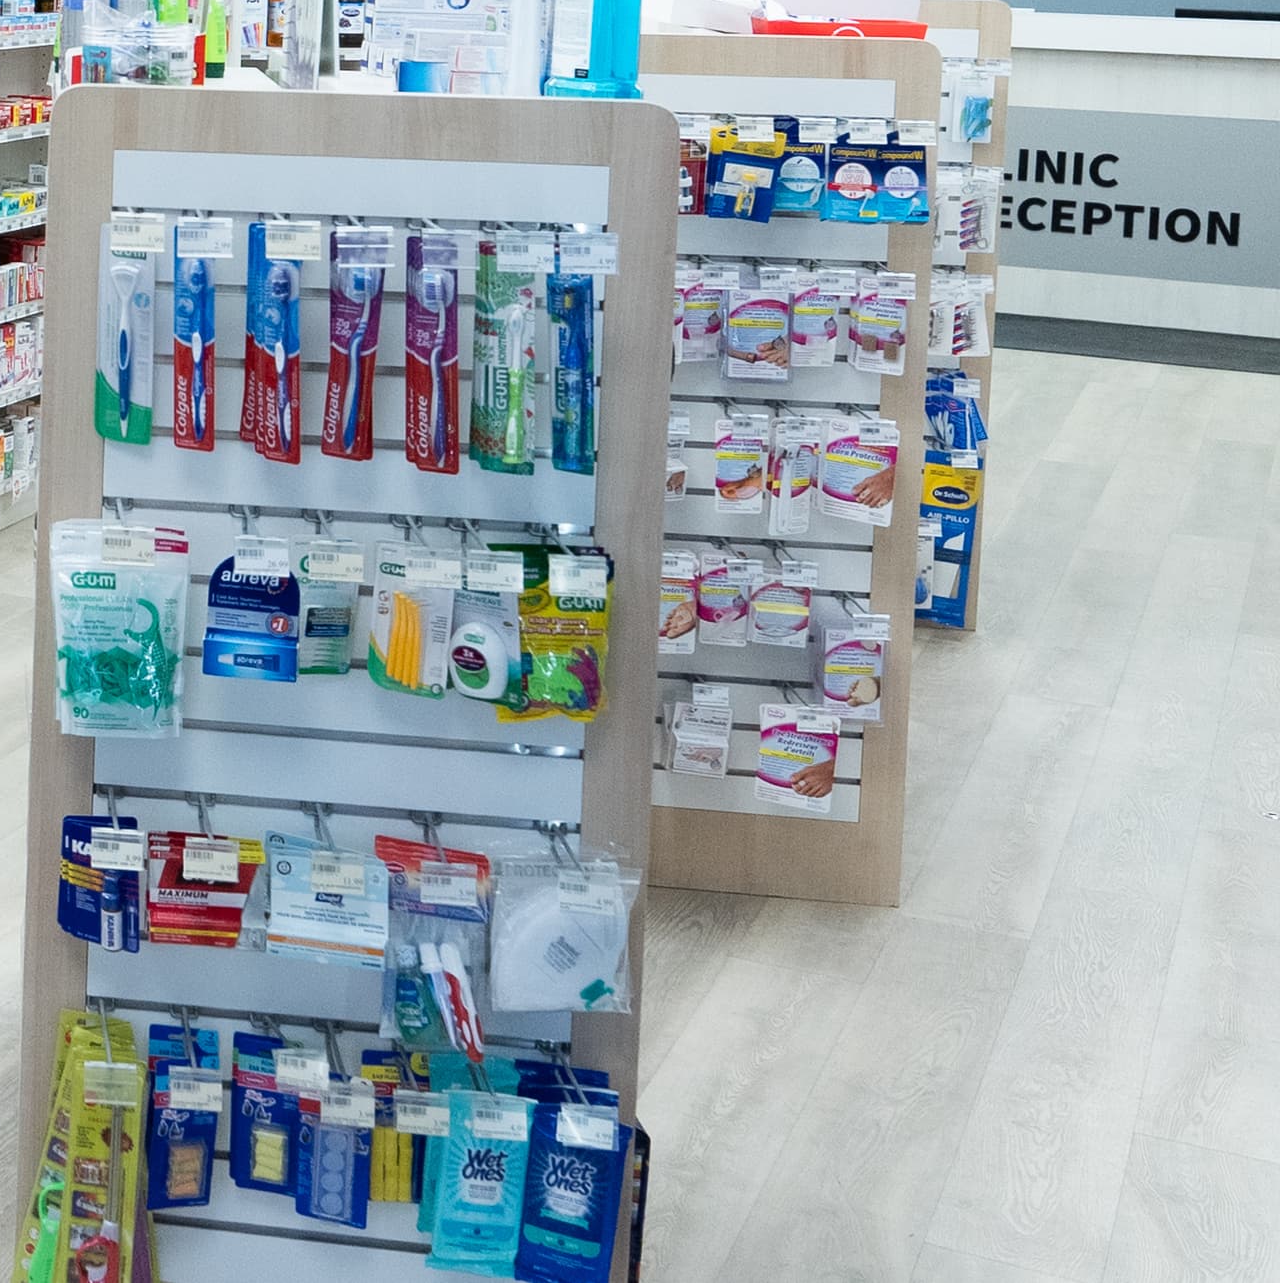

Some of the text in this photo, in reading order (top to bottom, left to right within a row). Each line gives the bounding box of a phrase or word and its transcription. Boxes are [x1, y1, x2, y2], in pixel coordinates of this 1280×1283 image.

[176, 374, 188, 437] Colgate
[323, 382, 341, 444] Colgate
[264, 386, 276, 449] Colgate
[417, 395, 429, 459] Colgate
[831, 447, 891, 464] Corn Protectors
[221, 570, 280, 588] abreva
[236, 655, 263, 665] abreva
[73, 706, 90, 719] 90
[158, 889, 209, 899] MAXIMUM
[466, 1148, 509, 1169] Wet
[549, 1155, 594, 1179] Wet
[461, 1164, 506, 1183] Ones
[544, 1171, 591, 1196] Ones
